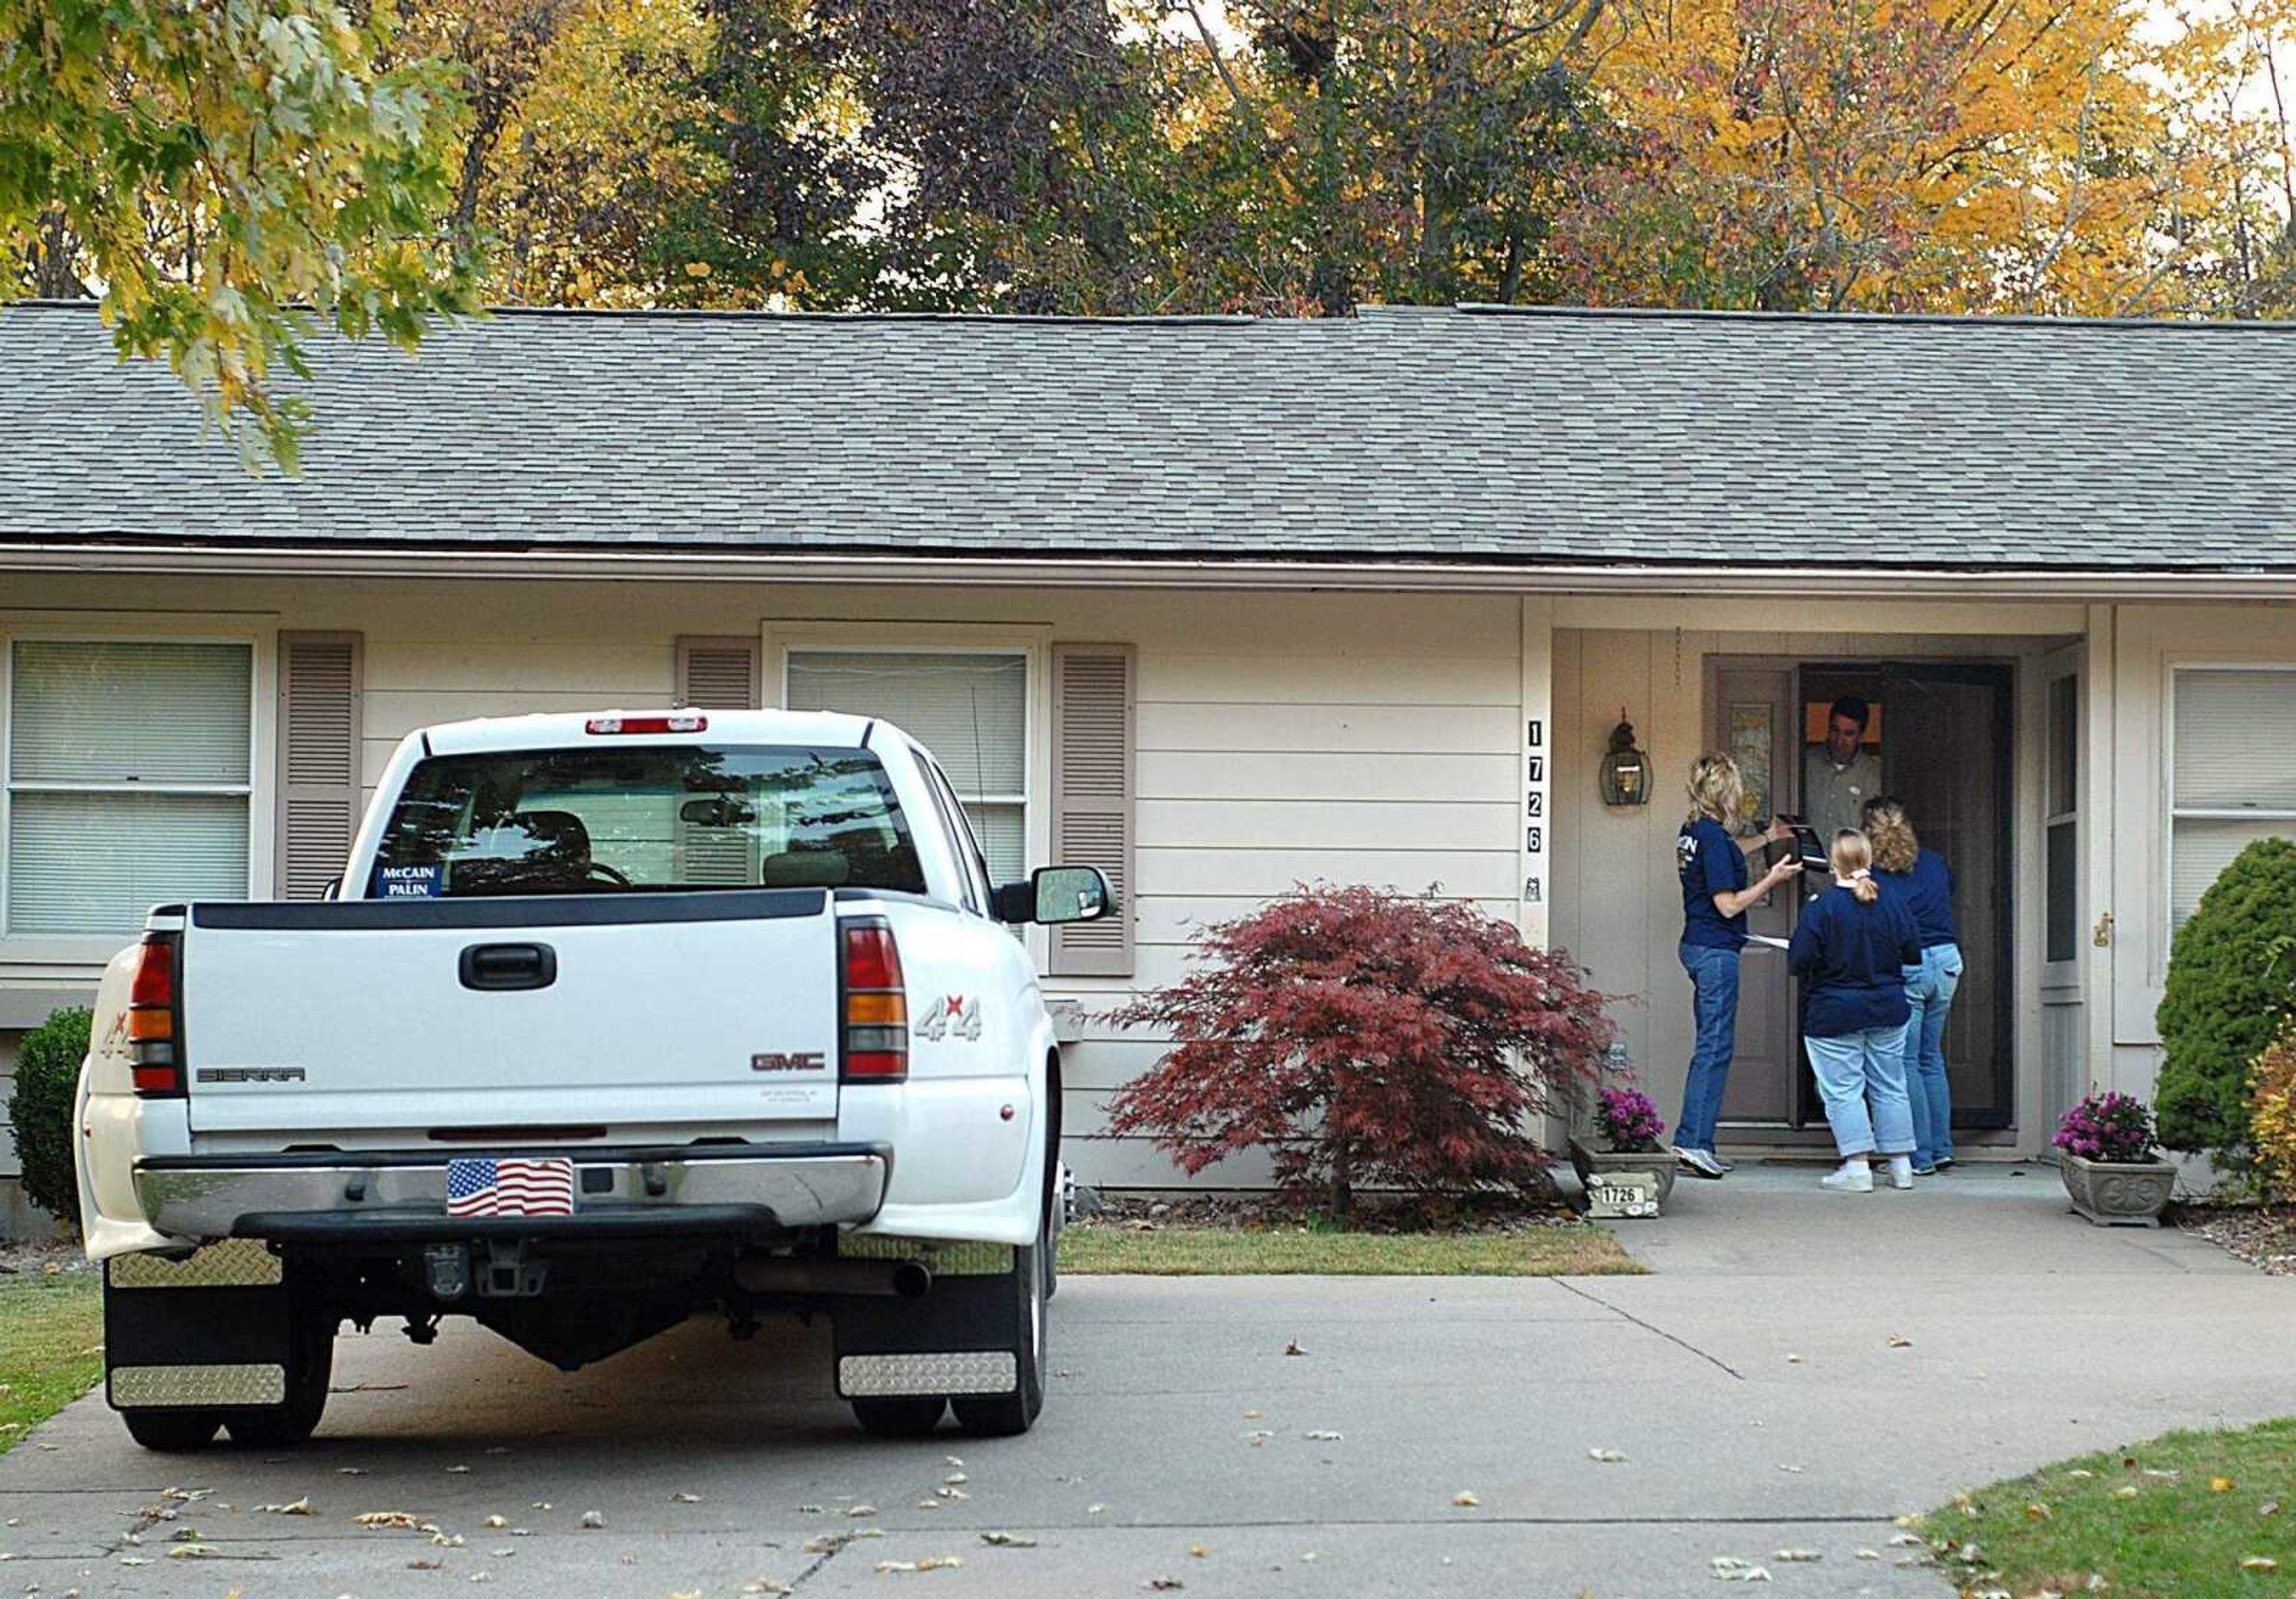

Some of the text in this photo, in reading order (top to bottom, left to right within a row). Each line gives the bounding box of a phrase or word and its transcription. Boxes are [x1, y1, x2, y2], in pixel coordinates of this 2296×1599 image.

[1528, 722, 1543, 850] 1726
[383, 868, 435, 878] McCAIN
[389, 884, 428, 895] PALIN
[752, 1052, 825, 1070] GMC
[197, 1067, 305, 1082] SIERRA
[1605, 1188, 1635, 1202] 1726
